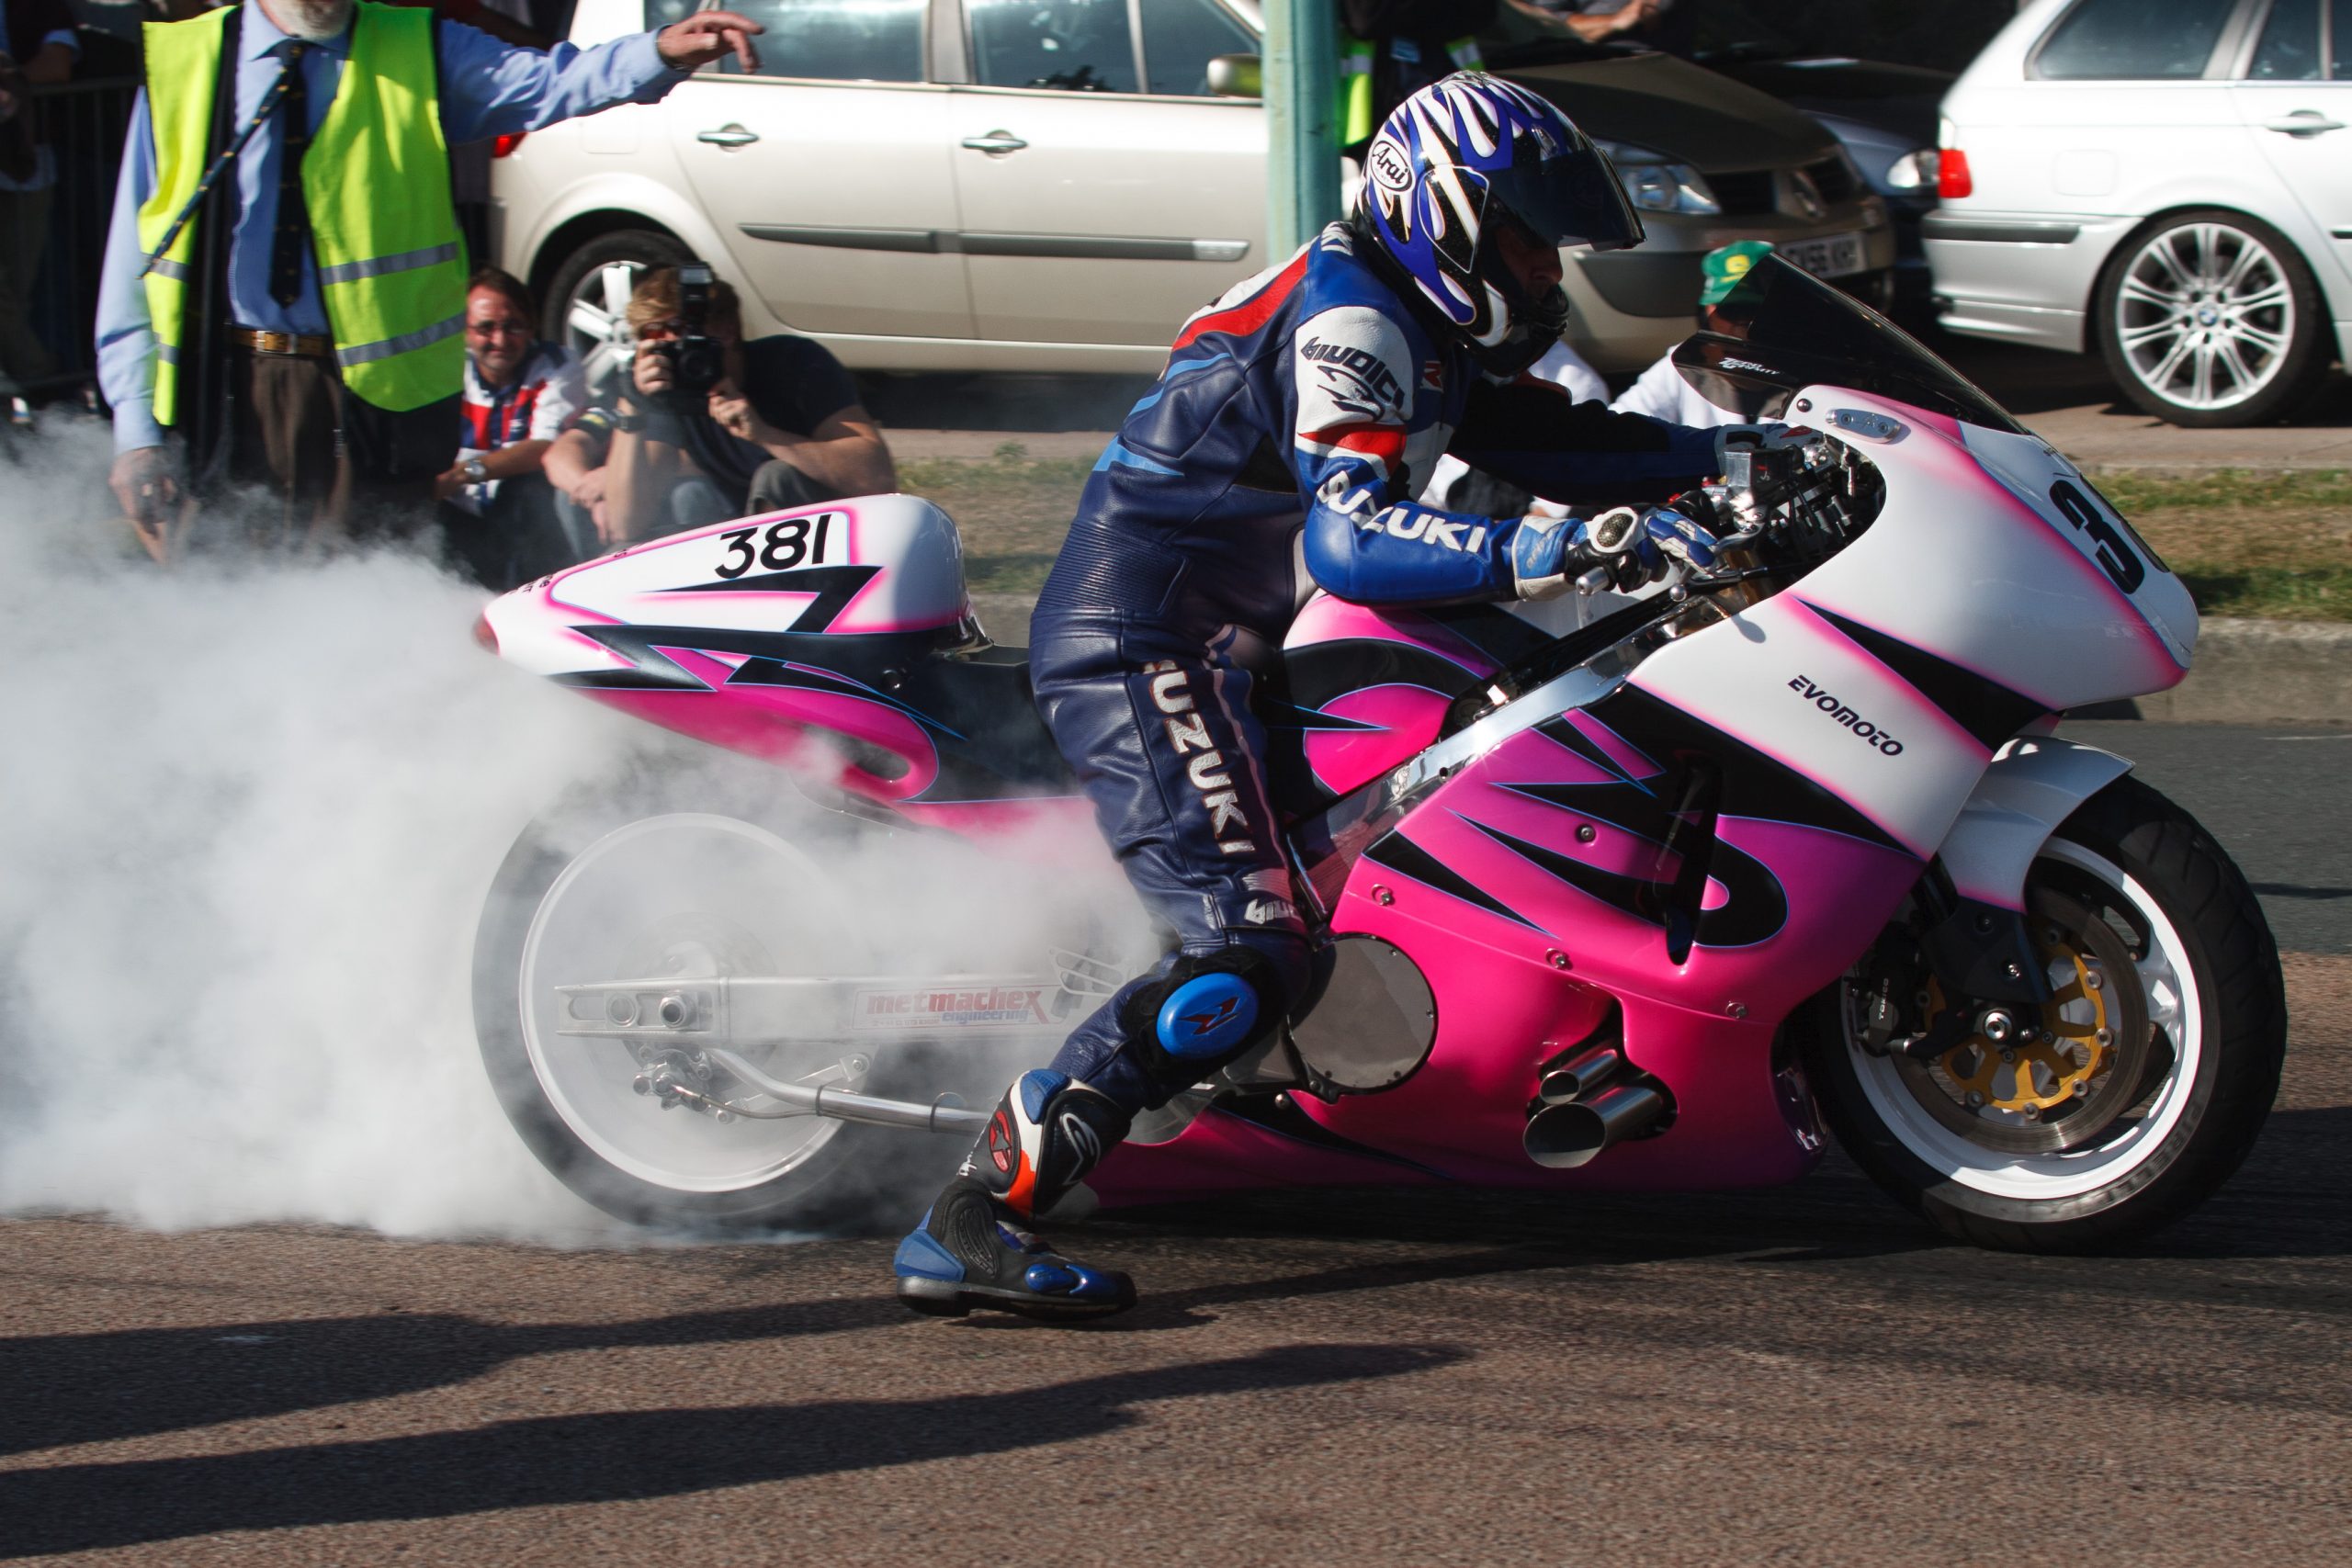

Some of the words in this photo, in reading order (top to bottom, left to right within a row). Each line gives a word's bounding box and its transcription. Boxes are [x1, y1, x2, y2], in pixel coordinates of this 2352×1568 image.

[1372, 147, 1408, 185] Arai
[714, 513, 832, 580] 381
[1787, 674, 1904, 756] EVOMOTO
[942, 1010, 1029, 1024] engineering
